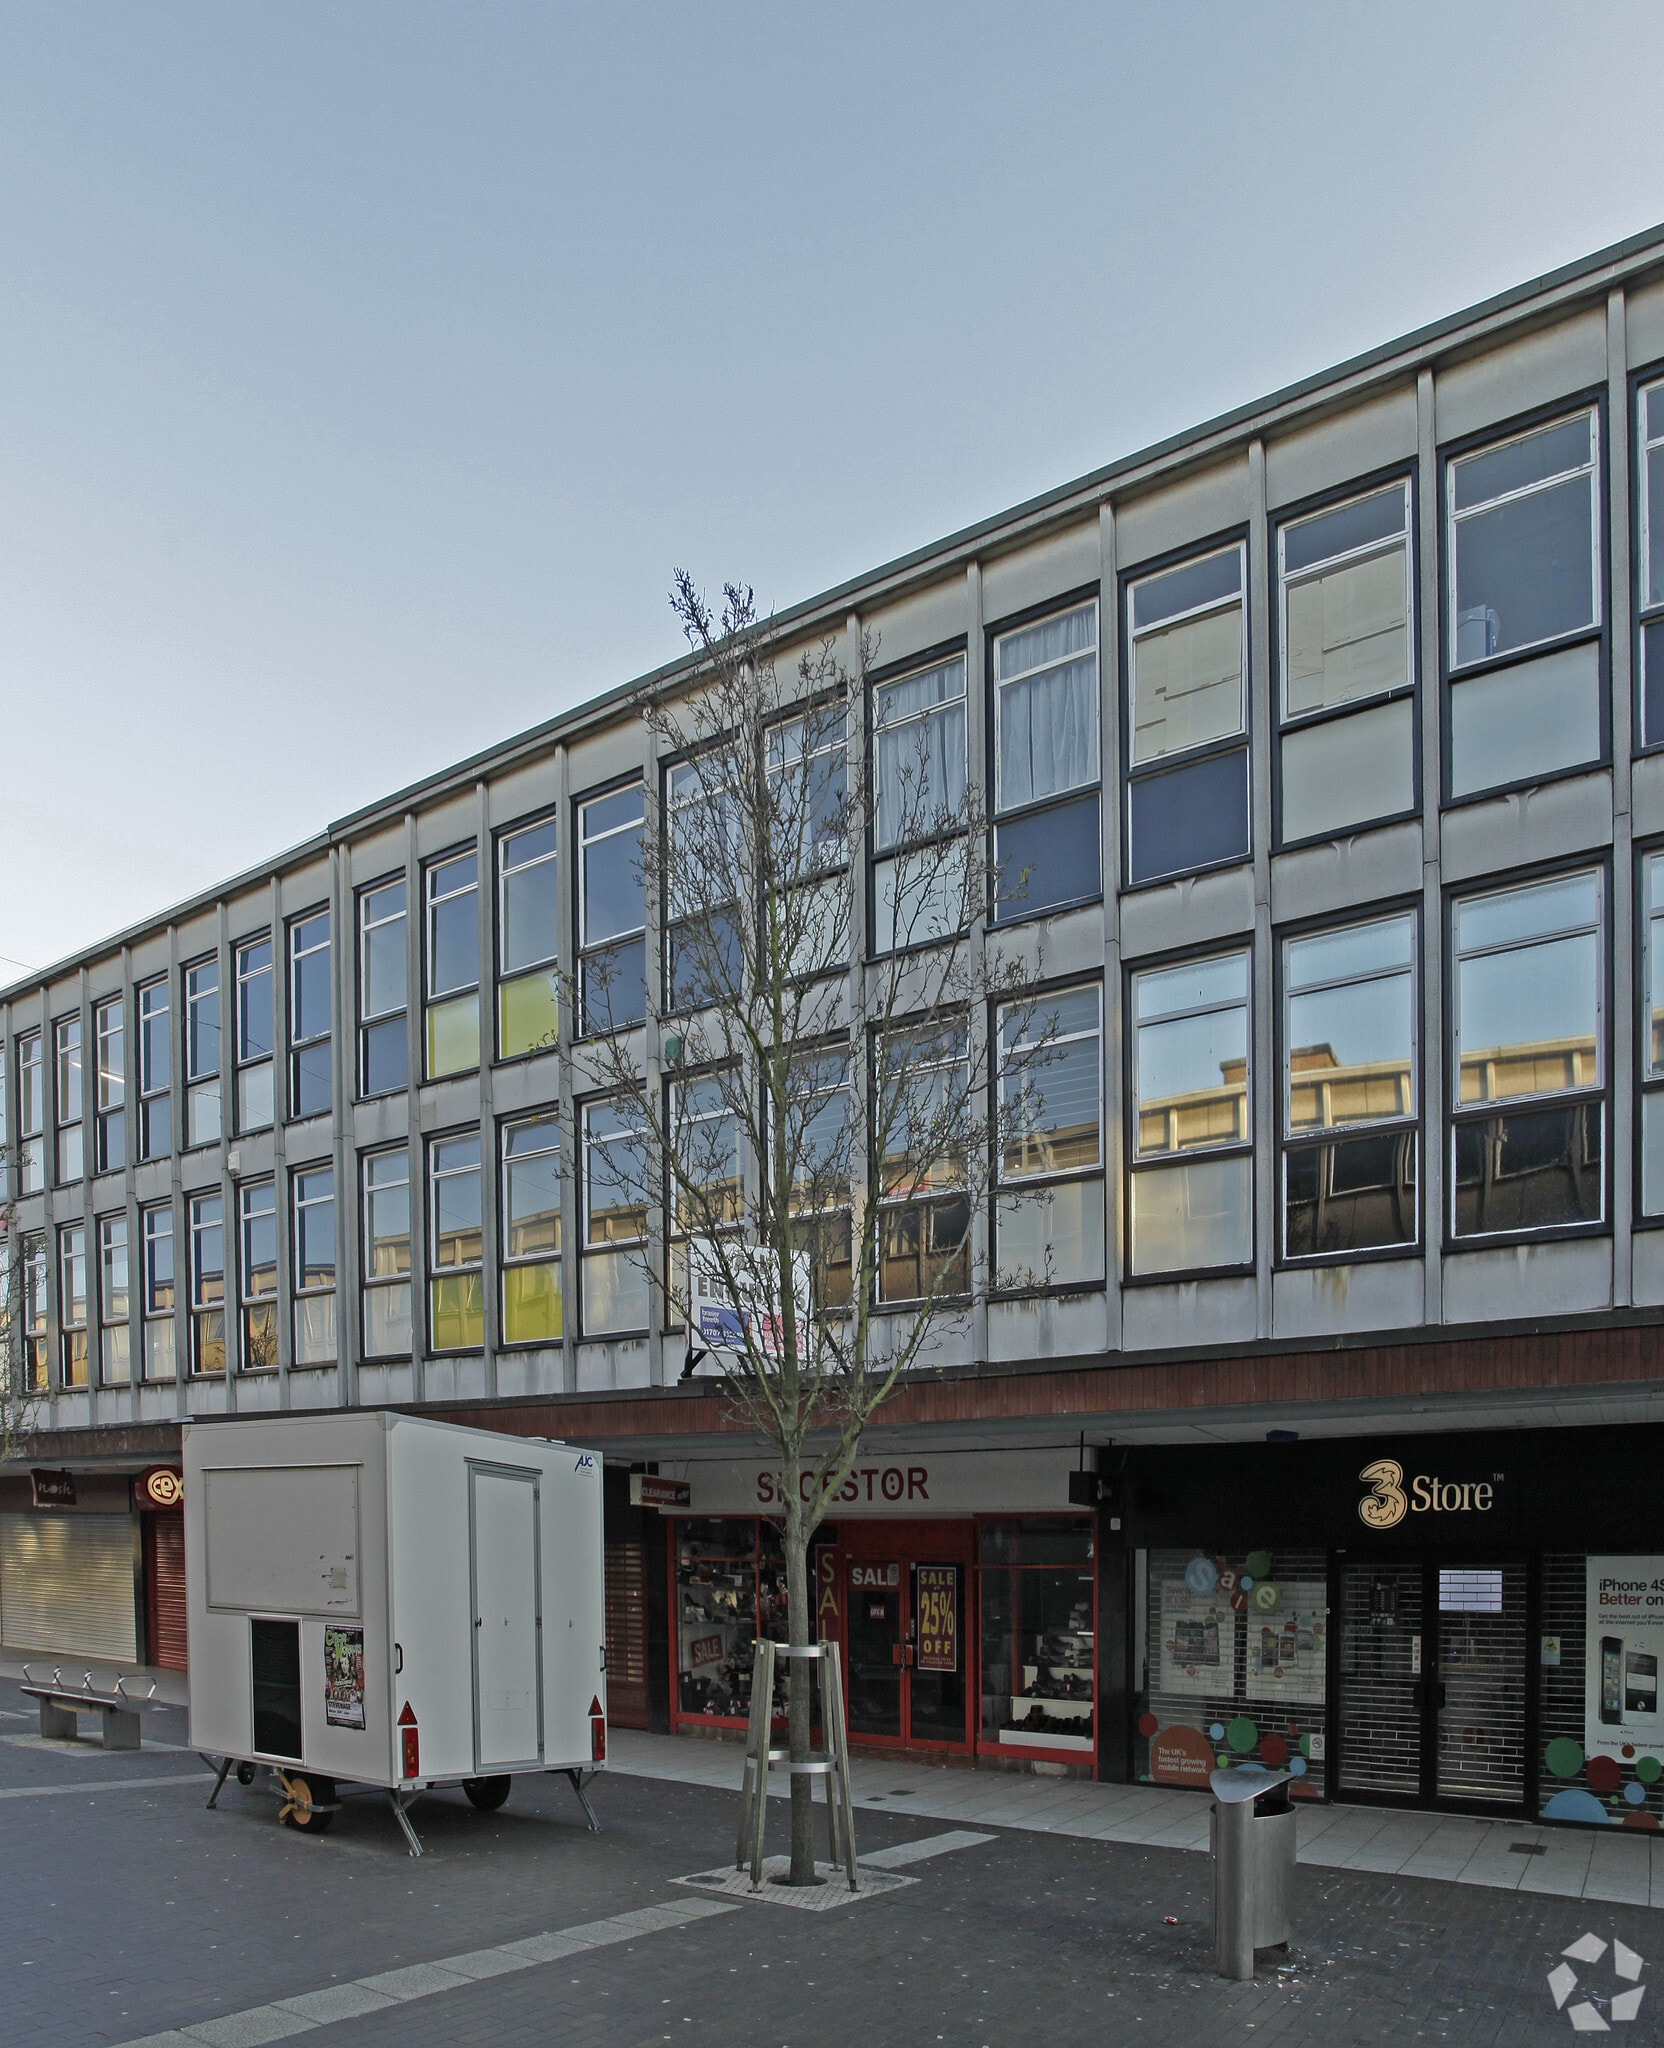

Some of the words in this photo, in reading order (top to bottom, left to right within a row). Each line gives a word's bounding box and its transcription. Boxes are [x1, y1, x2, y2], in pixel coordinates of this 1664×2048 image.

[38, 1482, 73, 1495] nosh
[641, 1487, 675, 1501] CLEARANCE
[1359, 1459, 1408, 1529] 3
[1411, 1475, 1493, 1512] Store
[920, 1571, 954, 1585] SALE
[1599, 1579, 1647, 1591] iPhone
[1599, 1593, 1643, 1605] Better
[1646, 1596, 1664, 1606] on
[870, 1607, 885, 1617] OPEN
[921, 1591, 954, 1636] 25%
[695, 1638, 720, 1664] SALE
[923, 1640, 951, 1654] OFF
[1158, 1747, 1170, 1755] The
[1171, 1748, 1186, 1756] UK's
[1158, 1755, 1179, 1763] fastest
[1180, 1758, 1206, 1767] growing
[1158, 1764, 1179, 1772] mobile
